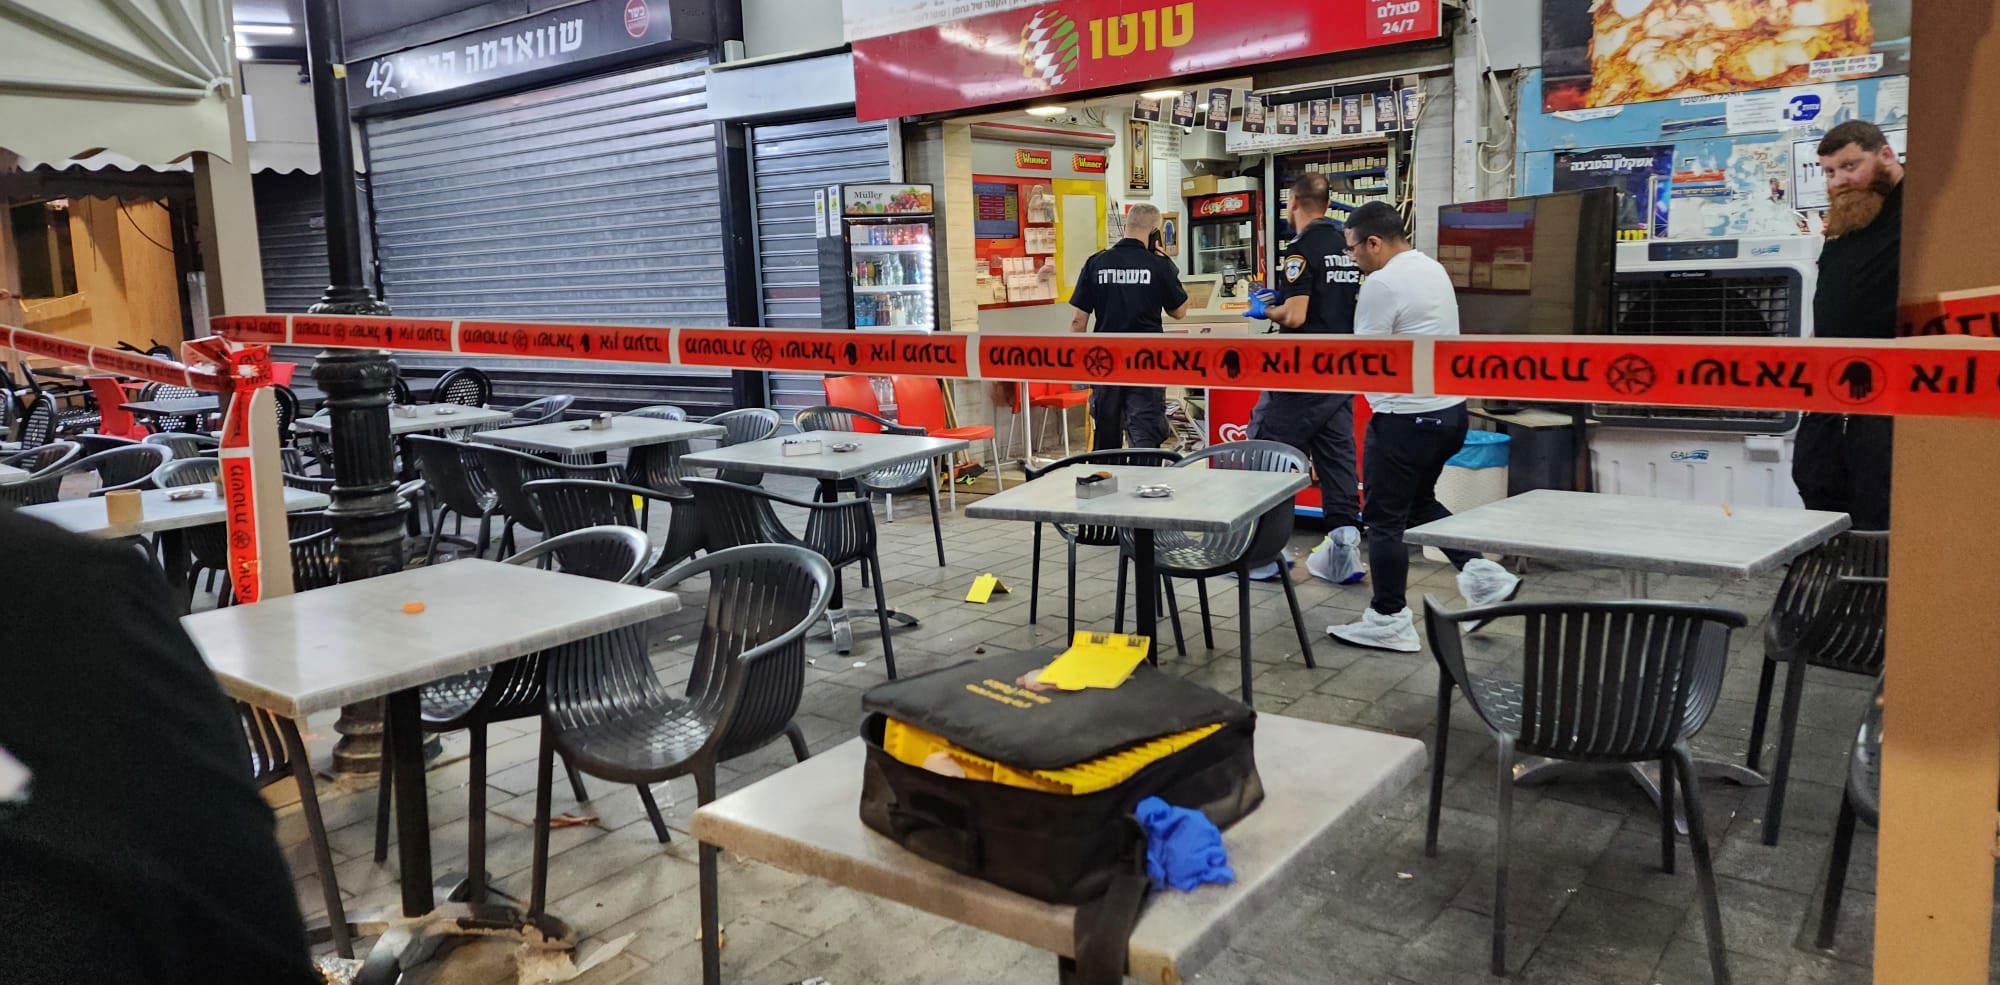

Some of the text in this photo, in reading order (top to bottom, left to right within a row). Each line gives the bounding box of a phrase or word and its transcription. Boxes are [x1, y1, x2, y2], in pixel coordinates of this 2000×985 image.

[1377, 1, 1420, 18] מצולם
[1089, 2, 1194, 60] טוטו
[1382, 19, 1415, 35] 24/7
[465, 19, 584, 73] שווארמה
[365, 61, 397, 97] 42
[1022, 152, 1049, 165] Winner
[1570, 157, 1654, 171] אשקלון והסביבה
[1098, 269, 1151, 285] משטרה
[1326, 270, 1360, 284] POLICE
[685, 337, 957, 366] משטרת ישראל אין מעבר
[989, 345, 1397, 379] משטרת ישראל אין מעבר
[1450, 354, 1977, 398] משטרת ישראל אין
[231, 464, 248, 524] משטרת
